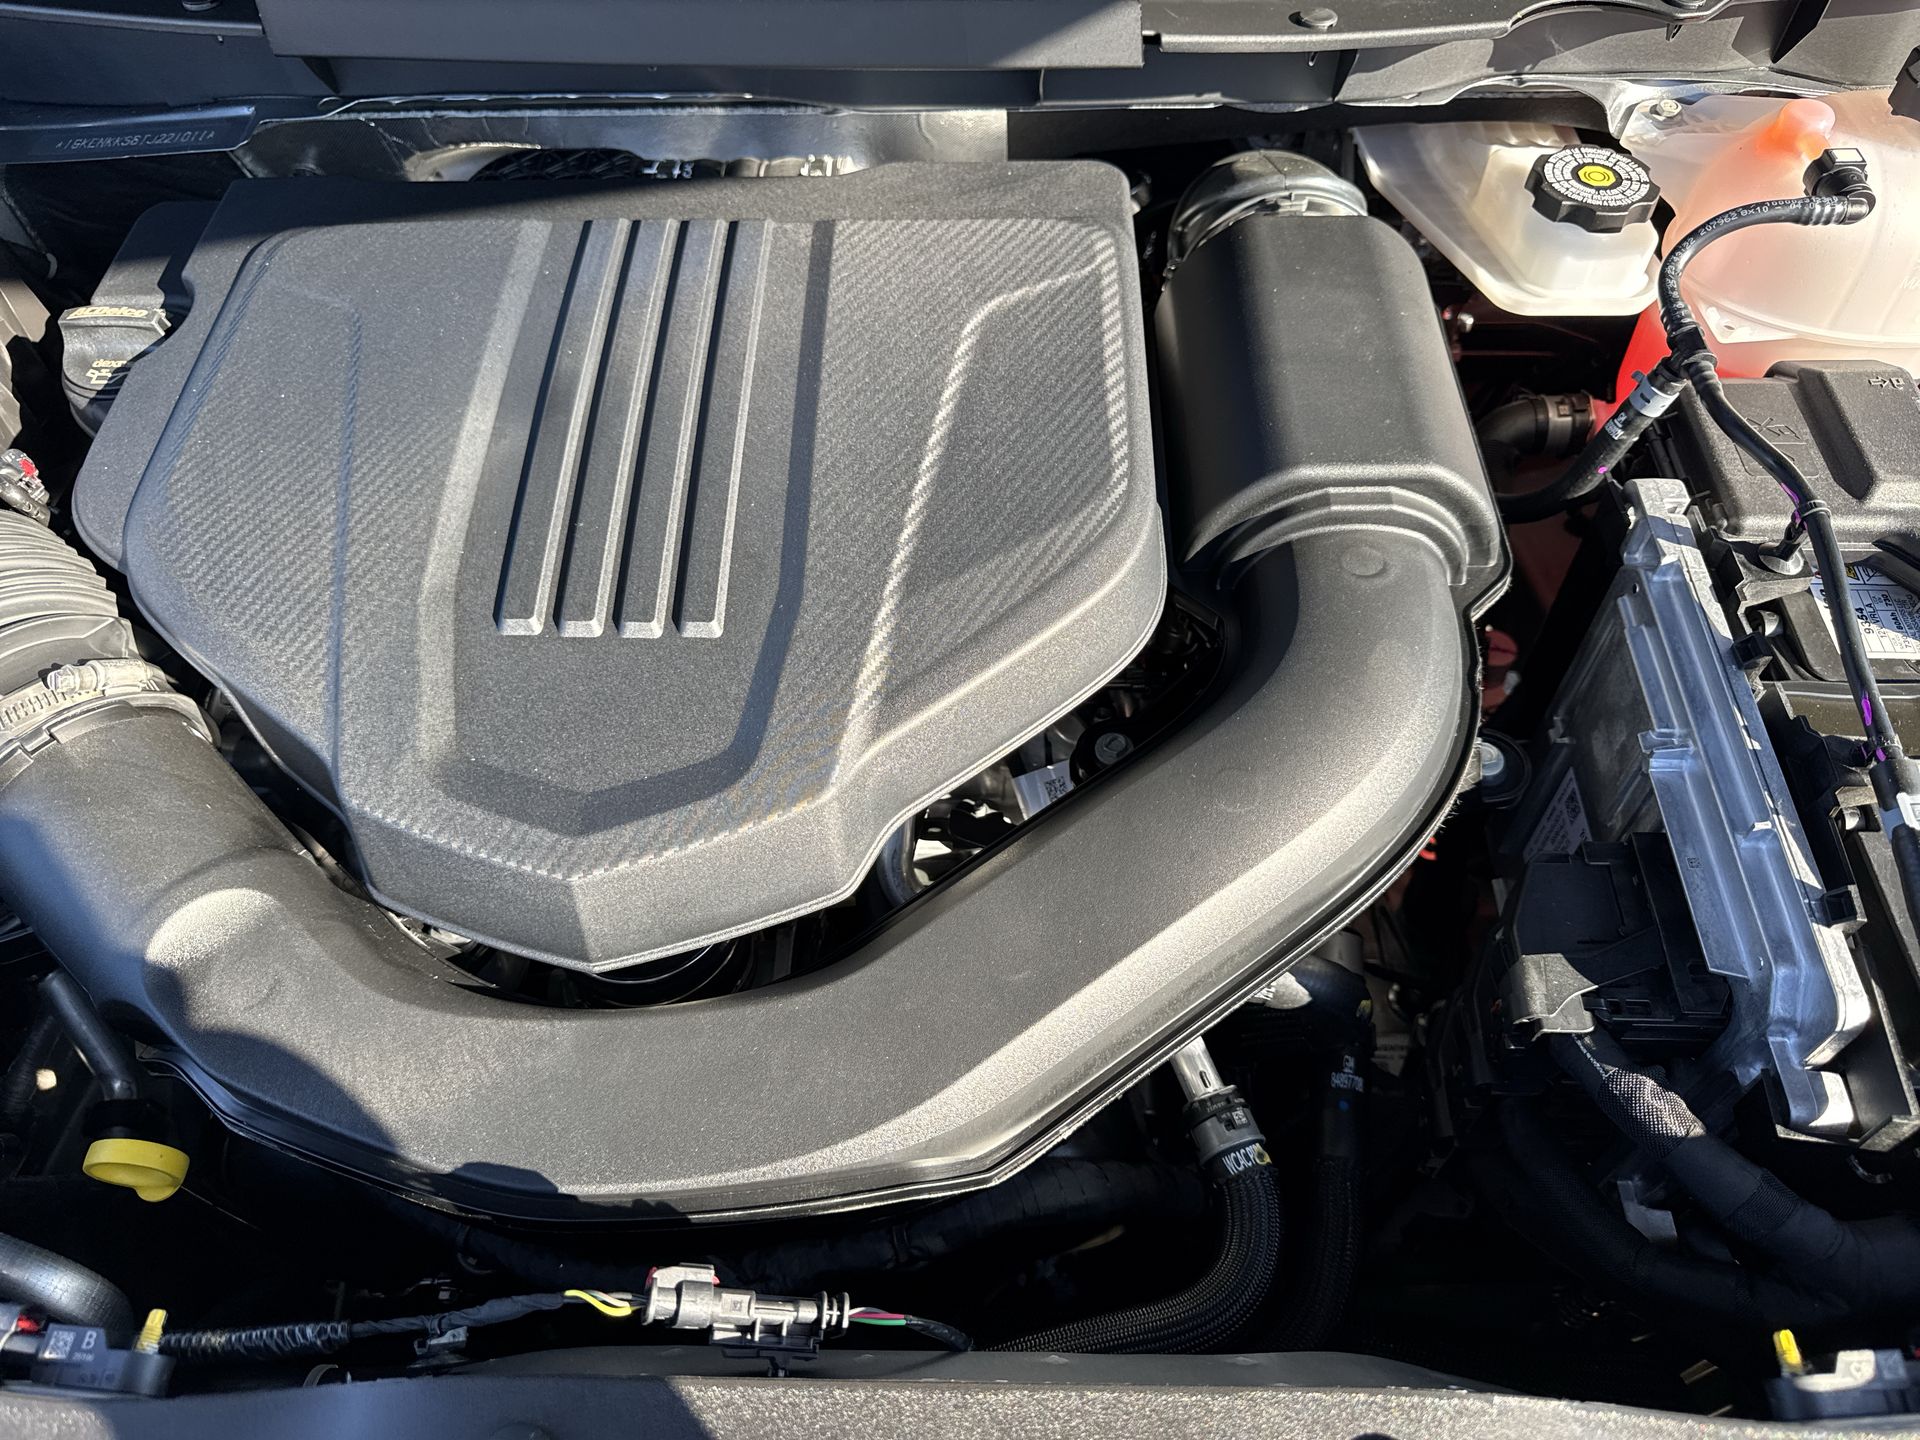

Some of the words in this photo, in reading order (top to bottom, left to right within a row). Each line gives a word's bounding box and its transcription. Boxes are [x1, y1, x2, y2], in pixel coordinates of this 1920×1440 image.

[66, 306, 148, 320] ACDelco
[1855, 607, 1875, 634] 9354
[1865, 603, 1880, 624] VRLA
[81, 1330, 97, 1350] B
